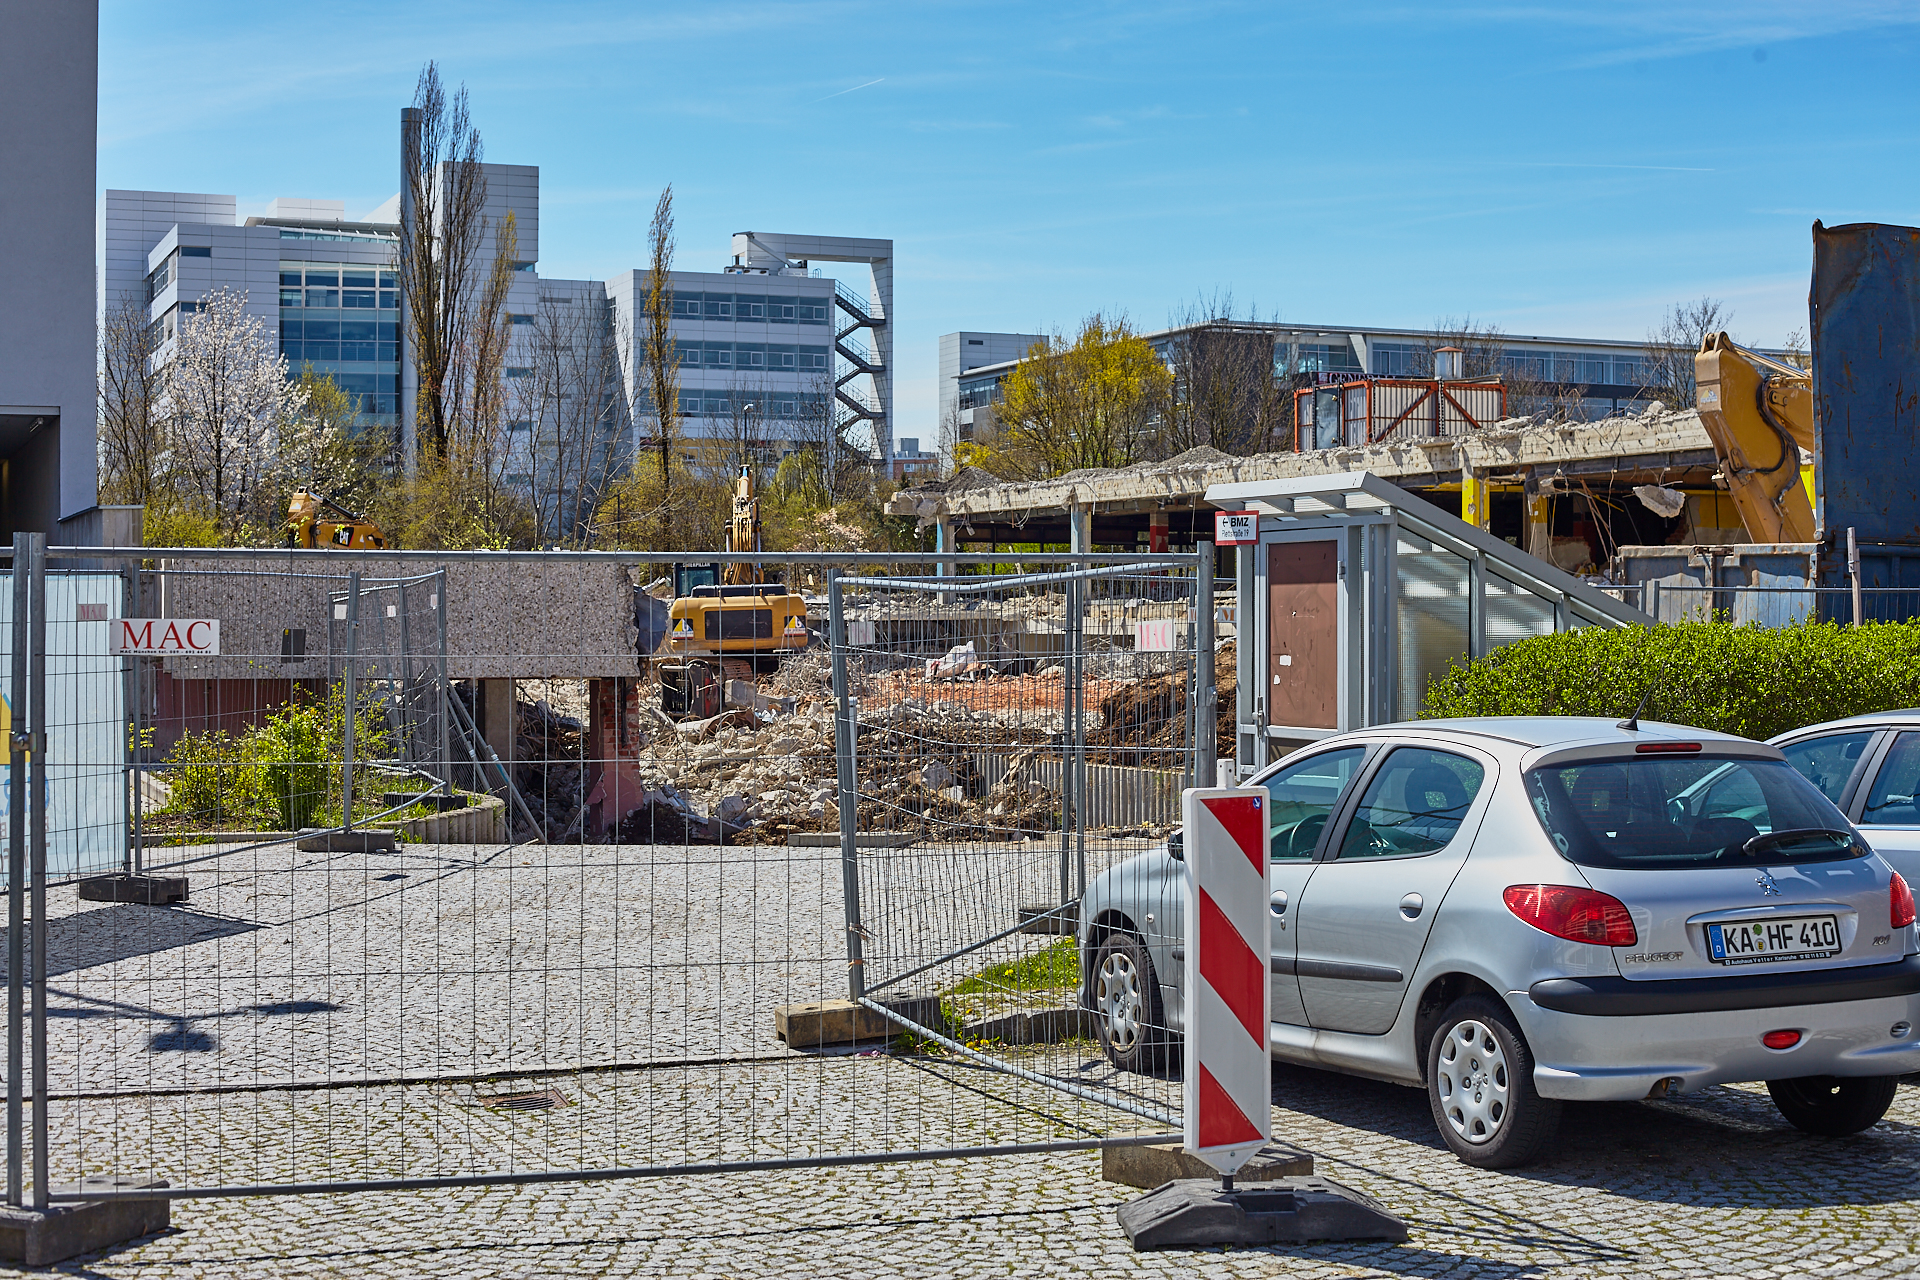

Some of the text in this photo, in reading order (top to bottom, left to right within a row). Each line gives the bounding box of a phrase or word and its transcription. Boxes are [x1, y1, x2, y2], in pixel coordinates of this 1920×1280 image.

[1231, 517, 1249, 527] BMZ
[81, 605, 106, 619] MAC
[120, 621, 211, 650] MAC
[1138, 623, 1171, 649] MAC
[1724, 921, 1836, 953] KA HF 410
[1625, 951, 1684, 963] PEUGEOT
